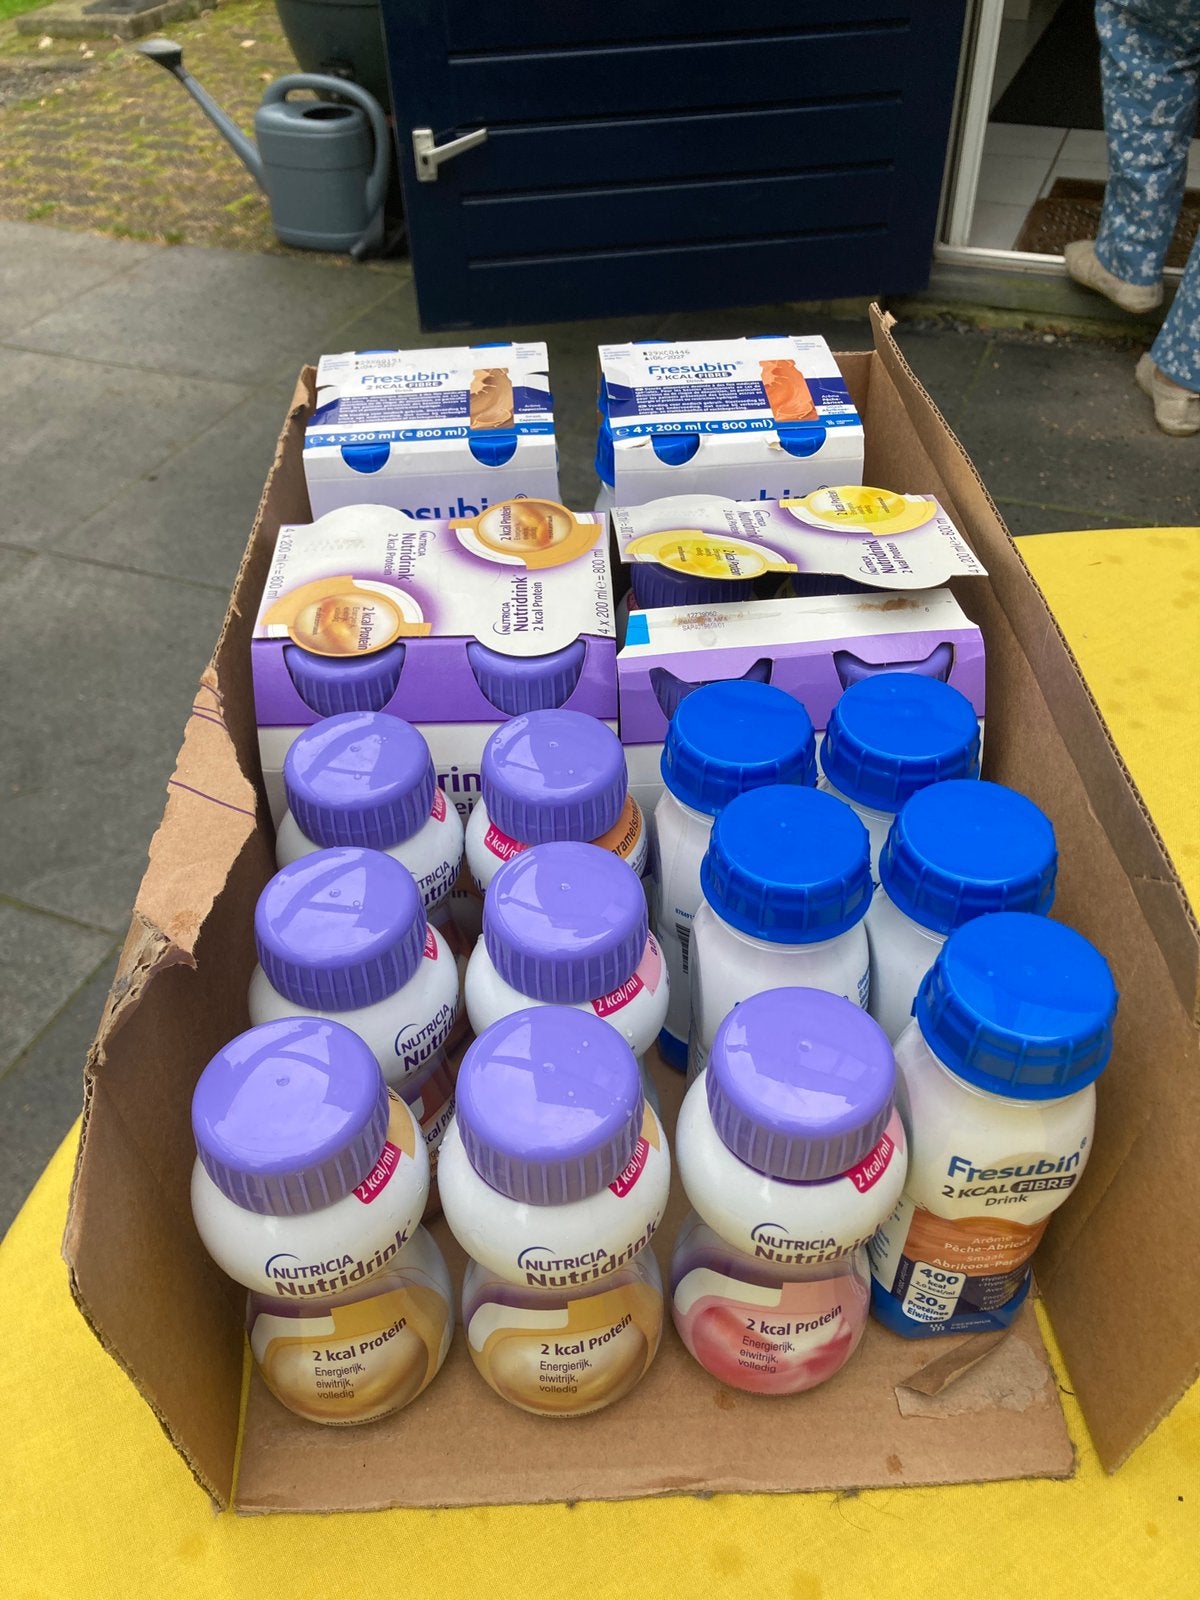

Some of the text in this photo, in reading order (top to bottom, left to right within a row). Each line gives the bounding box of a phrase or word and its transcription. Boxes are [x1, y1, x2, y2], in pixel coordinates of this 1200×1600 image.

[350, 433, 375, 441] 200
[379, 431, 395, 439] ml
[416, 429, 441, 438] 800
[445, 428, 468, 436] ml)
[633, 426, 642, 434] 4
[656, 424, 682, 432] 200
[751, 419, 773, 429] ml)
[397, 532, 417, 580] Nutridrink
[592, 559, 606, 574] 800
[531, 582, 543, 607] Protein
[511, 577, 529, 632] Nutridrink
[595, 602, 609, 619] 200
[361, 612, 376, 626] kcal
[502, 602, 511, 632] NUTRICIA
[532, 609, 544, 625] kcal
[357, 626, 373, 651] Protein
[487, 831, 519, 858] 2 kcal/m
[418, 861, 450, 890] TRICIA
[595, 976, 638, 1013] 2 kcal/ml
[401, 1004, 449, 1053] NUTRICIA
[615, 1141, 645, 1194] 2 kcal/ml
[855, 1174, 865, 1188] 2
[862, 1137, 891, 1181] kcal/ml
[357, 1146, 396, 1200] 2 kcal/ml
[942, 1177, 1072, 1198] 2 KCAL FIBRE
[985, 1194, 1028, 1206] Drink
[758, 1233, 836, 1250] NUTRICIA
[972, 1236, 1013, 1245] Arôme
[275, 1228, 408, 1296] Nutridrink
[526, 1220, 656, 1287] Nutridrink
[526, 1248, 608, 1272] NUTRICIA
[967, 1253, 1005, 1262] Smaak
[273, 1254, 354, 1280] NUTRICIA
[920, 1268, 959, 1286] 400
[928, 1280, 946, 1289] kcal
[914, 1292, 938, 1306] 20
[746, 1305, 842, 1335] 2 kcal Protein
[313, 1317, 407, 1361] 2 kcal Protein
[541, 1313, 632, 1356] 2 kcal Protein
[742, 1336, 795, 1353] Energierijk,
[740, 1348, 779, 1364] eiwitrijk,
[315, 1362, 366, 1378] Energierijk,
[540, 1358, 592, 1373] Energierijk,
[738, 1359, 777, 1374] volledig
[316, 1378, 354, 1389] eiwitrijk,
[539, 1373, 578, 1384] eiwitrijk,
[317, 1390, 355, 1400] volledig
[539, 1385, 578, 1393] volledig
